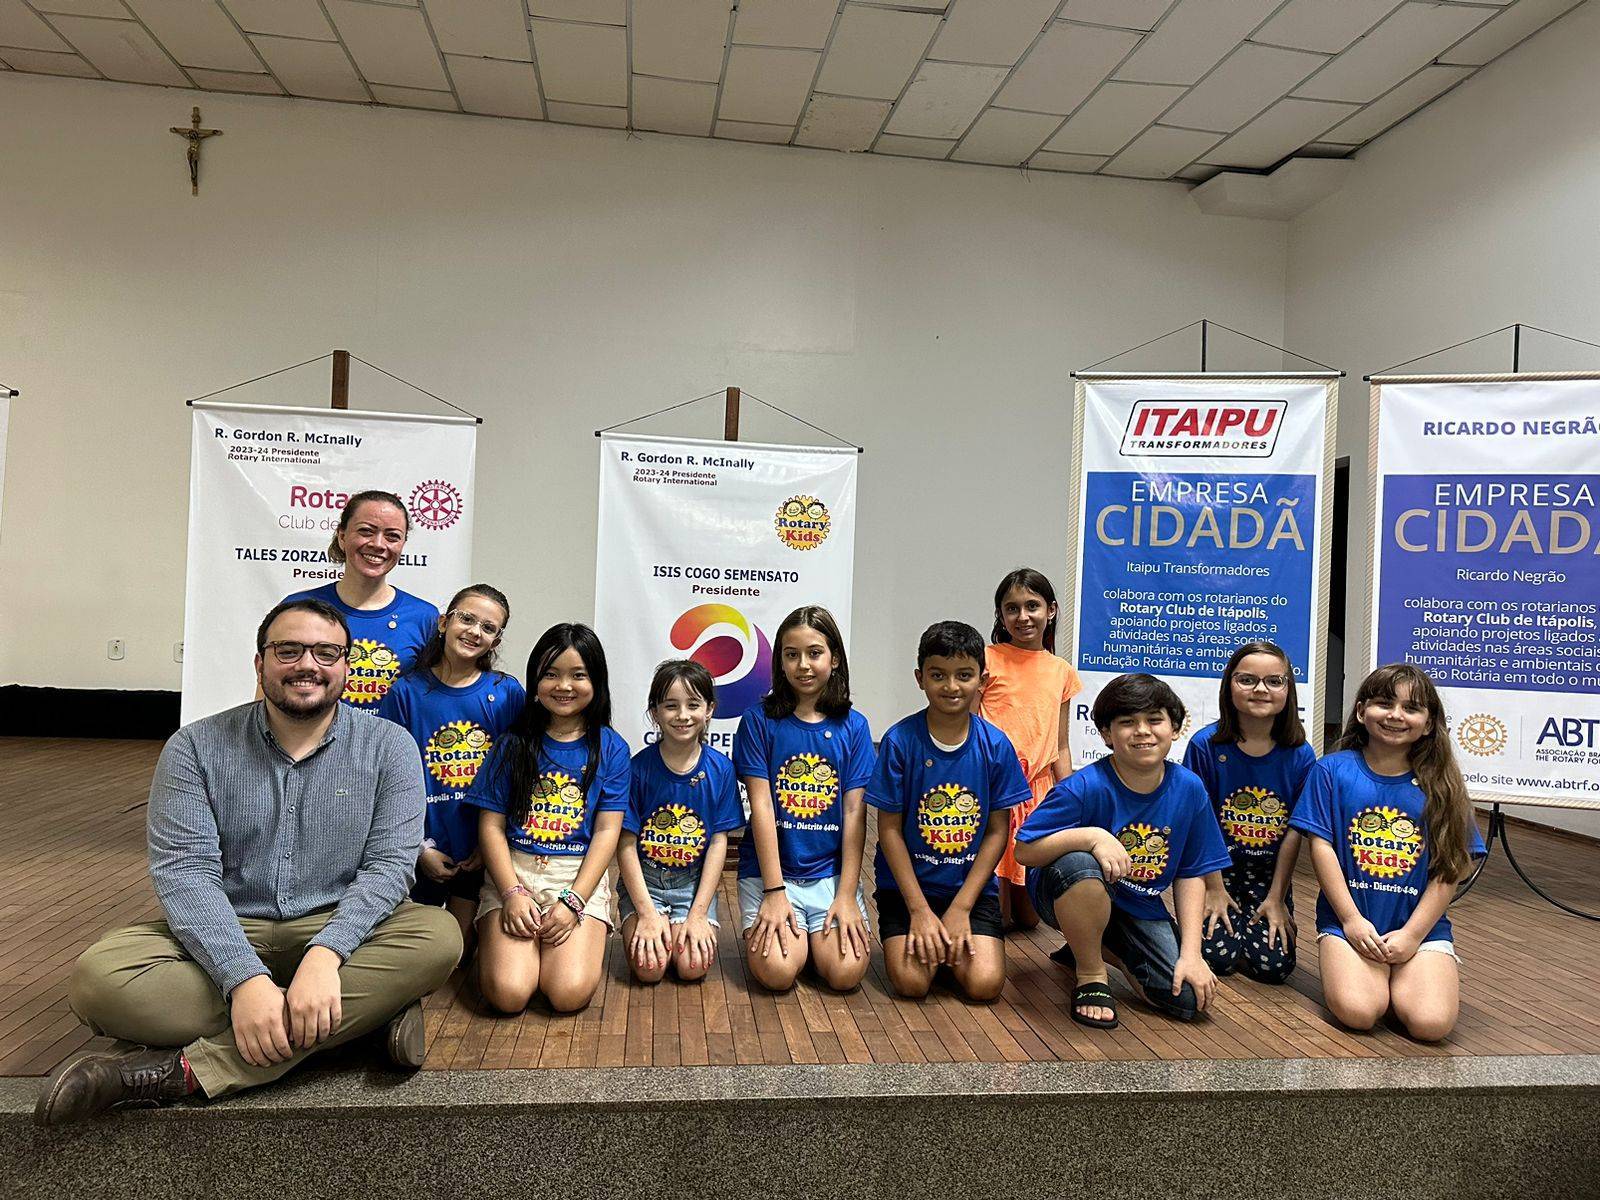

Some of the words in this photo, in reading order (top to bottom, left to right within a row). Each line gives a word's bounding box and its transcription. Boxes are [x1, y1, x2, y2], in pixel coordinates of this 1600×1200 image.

[1133, 408, 1278, 437] ITAIPU
[1423, 421, 1516, 436] RICARDO
[1523, 416, 1600, 435] NEGRÃ
[215, 428, 228, 439] R.
[233, 429, 282, 442] Gordon
[287, 432, 300, 443] R.
[304, 432, 362, 448] McInally
[1130, 440, 1268, 450] TRANSFORMADORES
[227, 453, 259, 463] Rotary
[262, 455, 321, 464] International
[230, 446, 269, 455] 2023-24
[271, 447, 320, 457] Presidente
[621, 452, 633, 462] R.
[637, 452, 682, 465] Gordon
[687, 456, 698, 465] R.
[703, 457, 755, 470] McInally
[633, 475, 661, 484] Rotary
[663, 477, 717, 486] International
[635, 468, 670, 477] 2023-24
[672, 470, 716, 479] Presidente
[290, 485, 349, 509] Rota
[1132, 481, 1269, 504] EMPRESA
[1435, 483, 1595, 506] EMPRESA
[278, 514, 315, 530] Club
[320, 517, 338, 530] de
[777, 517, 828, 531] Rotary
[1096, 497, 1305, 551] CIDADÃ
[785, 530, 821, 543] Kids
[1394, 508, 1600, 555] CIDAD
[235, 547, 277, 561] TALES
[281, 549, 332, 563] ZORZA
[293, 568, 345, 580] Preside
[653, 565, 681, 579] ISIS
[685, 567, 720, 580] COGO
[724, 568, 799, 583] SEMENSATO
[1127, 562, 1161, 576] Itaipu
[1163, 562, 1270, 577] Transformadores
[1456, 569, 1509, 582] Ricardo
[1513, 570, 1567, 586] Negrão
[692, 584, 760, 597] Presidente
[1103, 589, 1155, 602] colabora
[1158, 592, 1185, 602] com
[1188, 594, 1202, 603] os
[1205, 593, 1268, 605] rotarianos
[1271, 595, 1288, 606] do
[1120, 602, 1163, 617] Rotary
[1166, 604, 1195, 616] Club
[1198, 605, 1215, 617] de
[1218, 606, 1269, 620] Itápolis,
[1404, 597, 1463, 610] colabora
[1467, 601, 1497, 611] com
[1501, 602, 1518, 611] os
[1521, 601, 1596, 614] rotarianos
[1110, 616, 1167, 629] apoiando
[1170, 619, 1221, 632] projetos
[1224, 619, 1267, 634] ligados
[1270, 624, 1277, 633] a
[1423, 611, 1473, 627] Rotary
[1476, 613, 1511, 626] Club
[1513, 614, 1533, 627] de
[1536, 615, 1598, 630] Itápolis,
[1109, 628, 1169, 642] atividades
[1173, 633, 1194, 643] nas
[1198, 632, 1231, 645] áreas
[1412, 626, 1478, 640] apoiando
[1481, 629, 1541, 643] projetos
[1544, 629, 1595, 645] ligados
[1103, 641, 1182, 656] humanitárias
[1185, 648, 1193, 657] e
[1196, 646, 1234, 658] ambie
[1411, 640, 1481, 653] atividades
[1485, 643, 1510, 654] nas
[1513, 642, 1553, 656] áreas
[1082, 653, 1140, 669] Fundação
[1143, 656, 1186, 670] Rotária
[1189, 661, 1209, 671] em
[1405, 653, 1496, 668] humanitárias
[1500, 659, 1508, 668] e
[1512, 656, 1592, 672] ambientais
[347, 666, 396, 680] otary
[1451, 669, 1500, 682] Rotária
[1504, 674, 1528, 684] em
[1531, 672, 1565, 686] todo
[1569, 677, 1578, 686] o
[345, 680, 387, 694] Kids
[1536, 717, 1600, 748] ABT
[1552, 756, 1584, 764] ROTARY
[440, 763, 477, 778] Kid
[779, 778, 835, 795] Rotary
[1491, 774, 1513, 786] site
[1516, 777, 1600, 792] www.abtrf.o
[531, 801, 582, 819] otary
[785, 793, 827, 810] Kids
[526, 815, 571, 832] Kids
[920, 813, 978, 826] Rotary
[1224, 809, 1284, 826] Rotary
[643, 829, 703, 847] Rotary
[929, 828, 973, 843] Kids
[1232, 823, 1277, 839] Kids
[1351, 831, 1419, 855] Rotary
[651, 845, 694, 862] Kids
[1130, 853, 1166, 866] tary
[1359, 849, 1411, 869] Kids
[1130, 865, 1155, 879] ids
